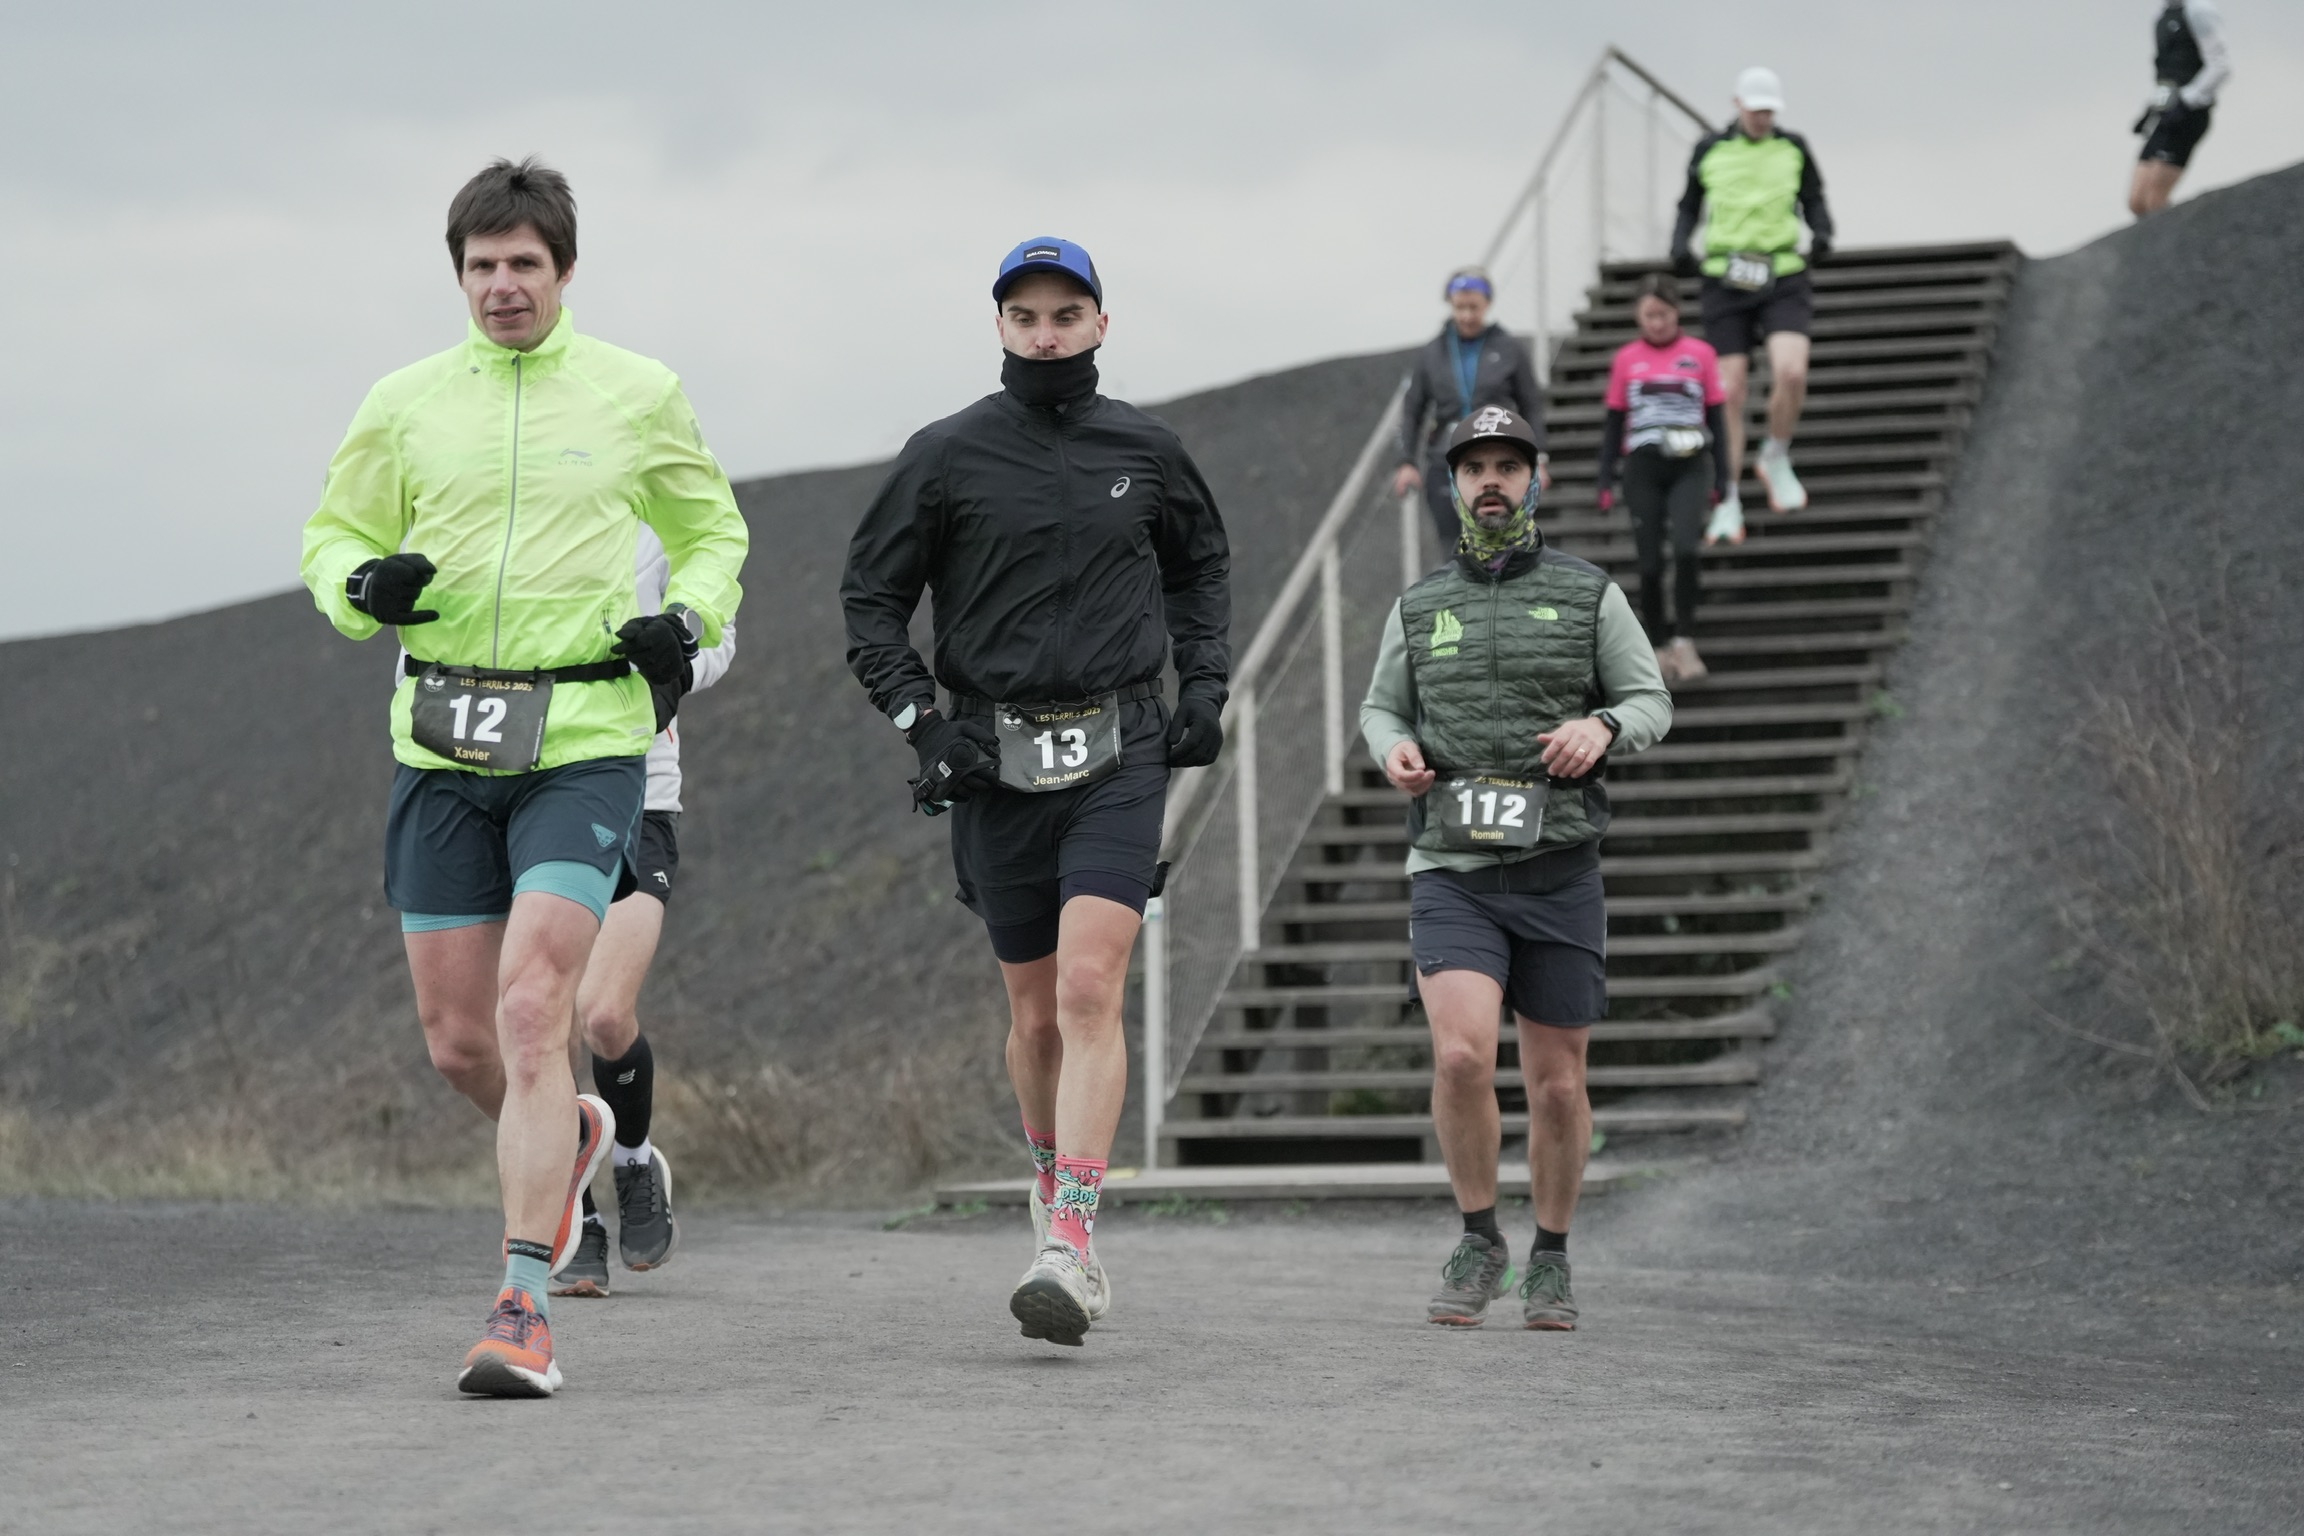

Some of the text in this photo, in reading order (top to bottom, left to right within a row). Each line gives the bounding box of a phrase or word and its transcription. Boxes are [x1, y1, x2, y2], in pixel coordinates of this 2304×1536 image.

[1432, 646, 1459, 657] FINISHER
[460, 678, 476, 687] LES
[512, 682, 534, 692] 2025
[449, 694, 507, 743] 12
[1035, 713, 1050, 722] LES
[454, 747, 490, 761] Xavier
[1034, 728, 1088, 769] 13
[1033, 769, 1089, 786] Jean-Marc
[1516, 780, 1534, 789] 225
[1457, 789, 1527, 827] 112
[1471, 829, 1504, 840] Romain
[1060, 1187, 1098, 1205] DBDB
